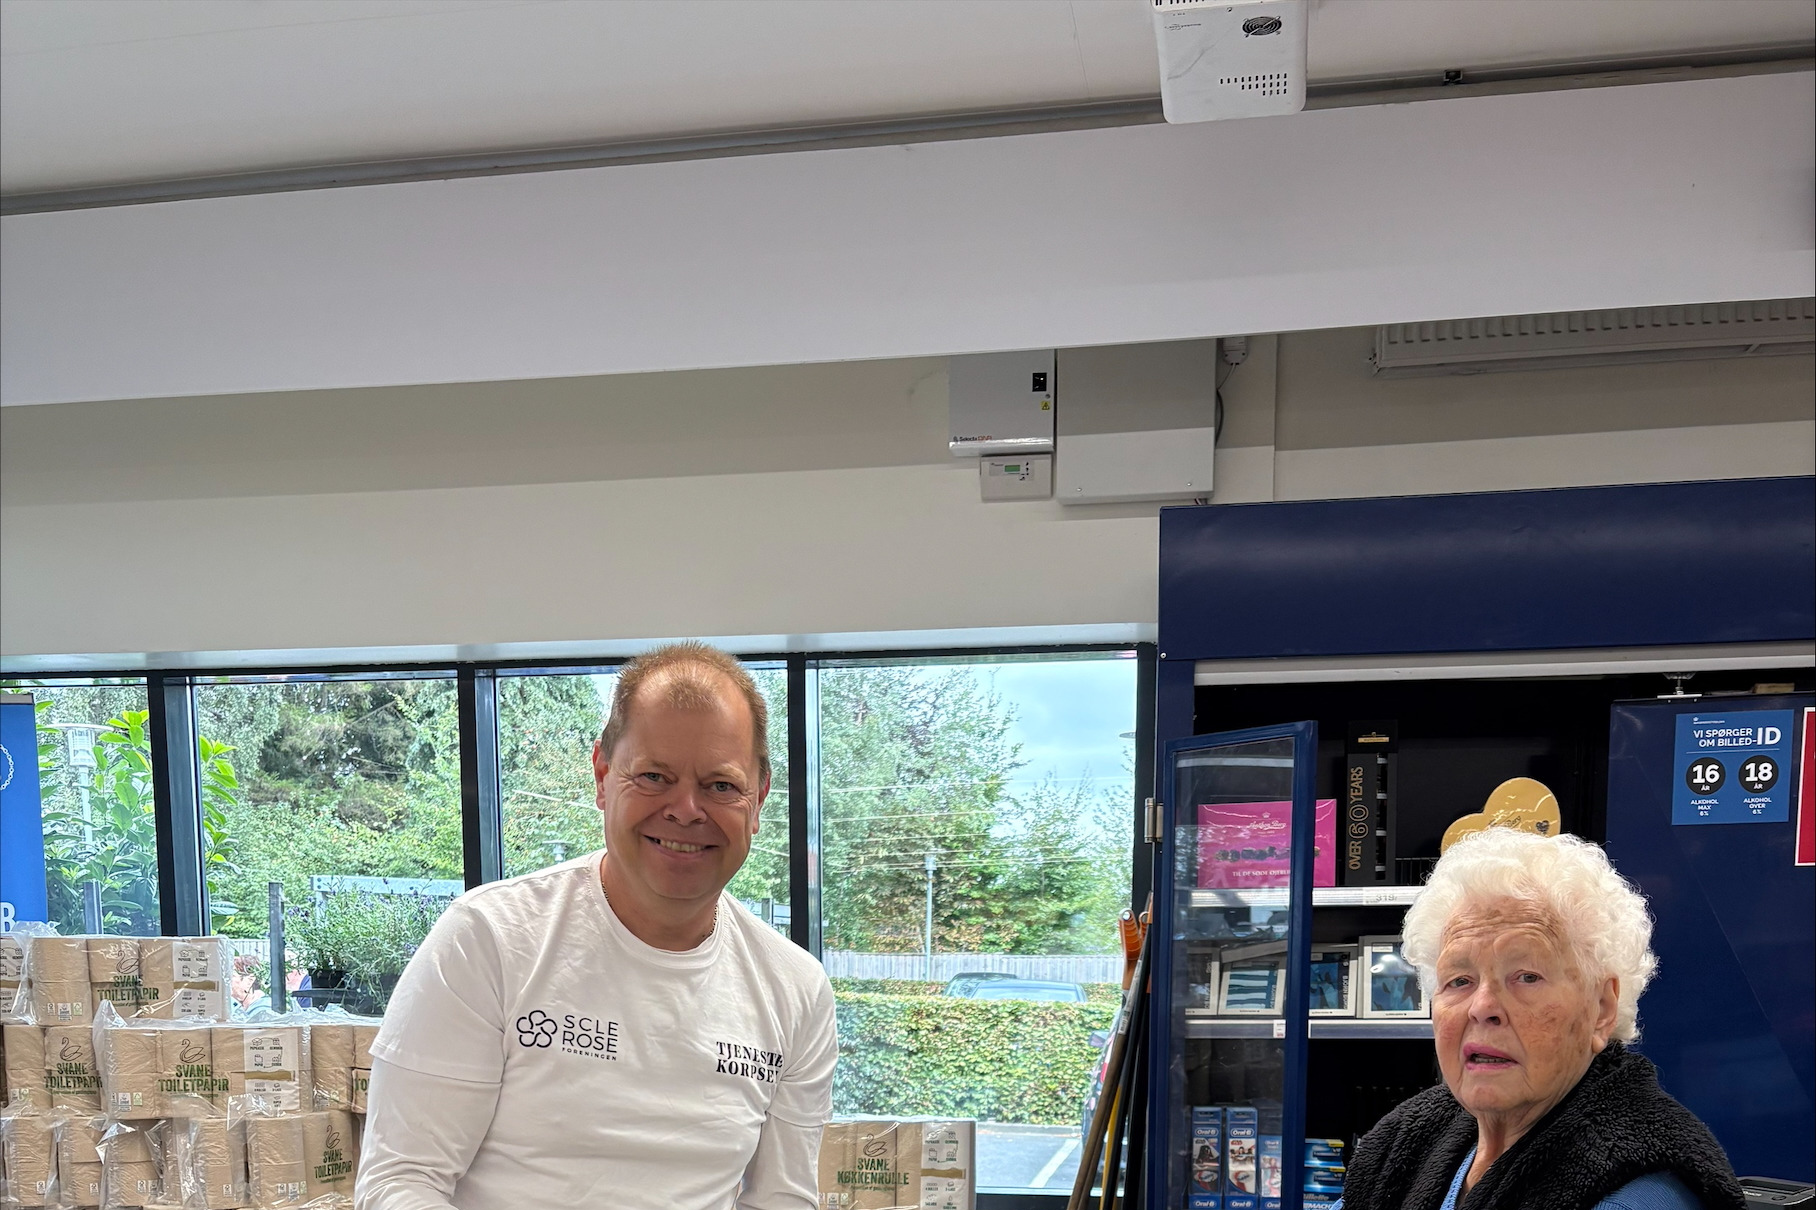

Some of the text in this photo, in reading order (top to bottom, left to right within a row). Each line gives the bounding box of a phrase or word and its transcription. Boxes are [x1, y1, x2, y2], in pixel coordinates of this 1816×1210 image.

[1693, 728, 1753, 739] VI SPØRGER
[1699, 738, 1715, 747] OM
[1692, 762, 1773, 784] 16 18
[1349, 766, 1369, 870] OVER 60 YEARS
[97, 988, 160, 1002] TOILETPAPIR
[563, 1014, 619, 1038] SCLE
[562, 1030, 618, 1054] ROSE
[562, 1046, 618, 1062] FORENINGEN
[56, 1062, 88, 1075] SVANE
[176, 1064, 212, 1078] SVANE
[158, 1079, 230, 1092] TOILETPAPIR
[323, 1149, 344, 1162] SVANE
[314, 1161, 352, 1178] TOILETPAPIR
[857, 1158, 890, 1171] SVANE
[837, 1170, 910, 1186] KØKKENRULLE
